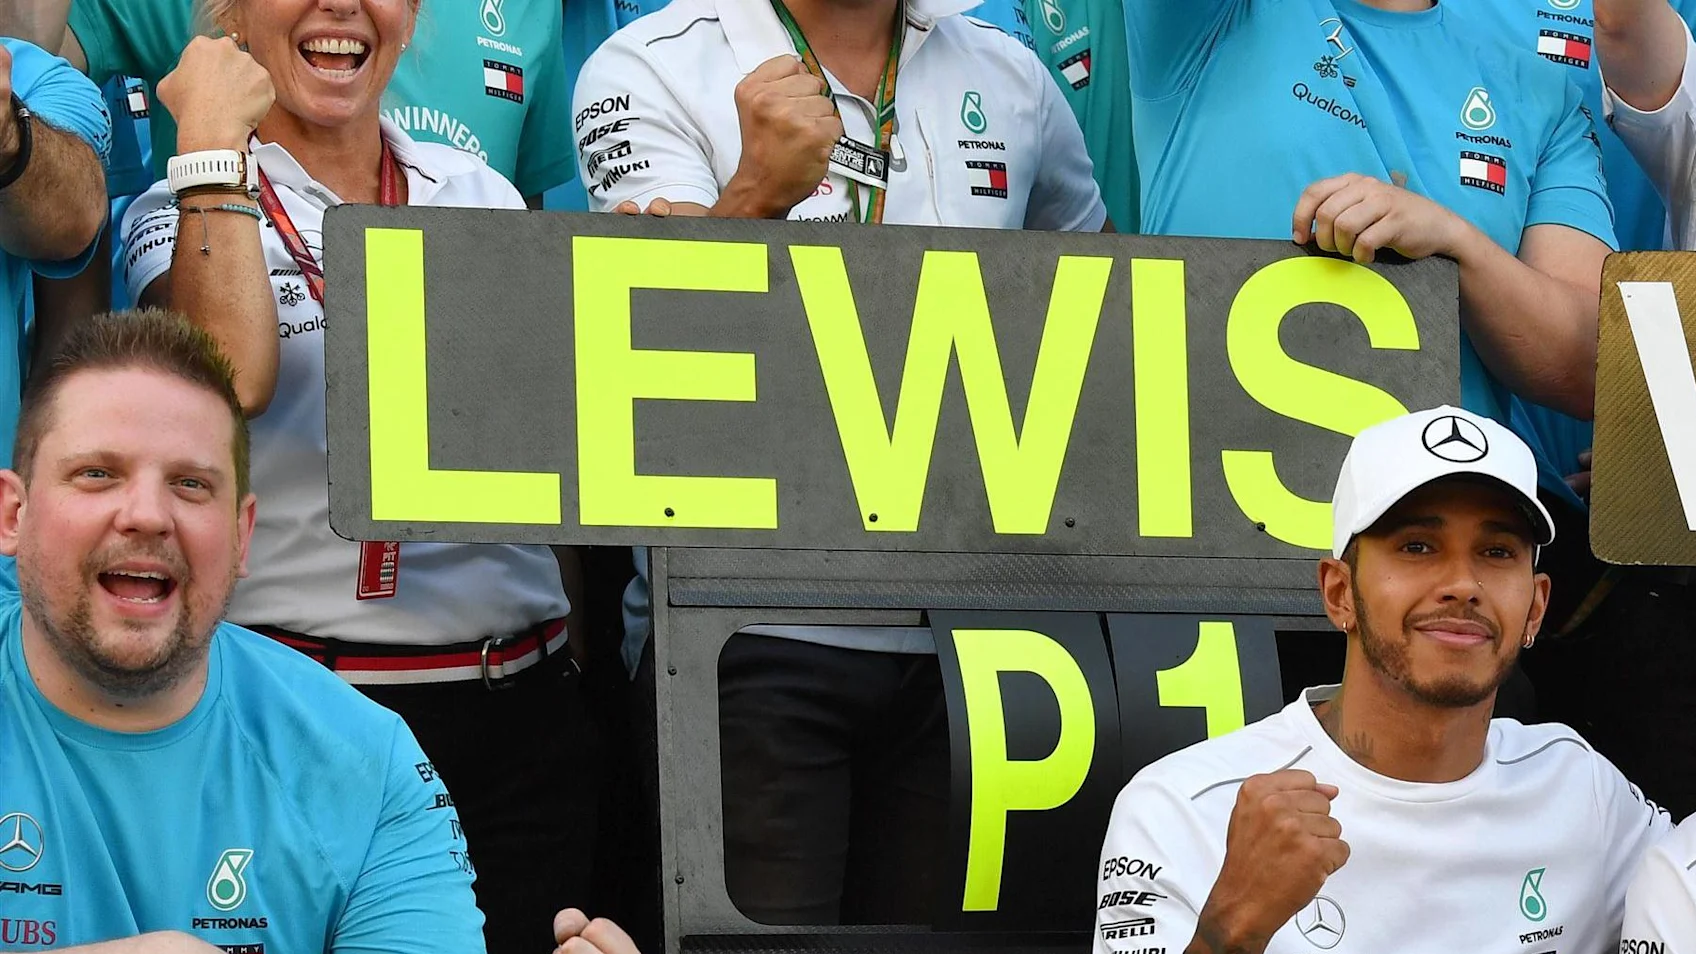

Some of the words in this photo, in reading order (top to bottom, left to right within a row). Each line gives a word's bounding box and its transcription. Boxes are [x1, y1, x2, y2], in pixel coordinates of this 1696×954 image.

[1536, 10, 1594, 27] PETRONAS
[1543, 30, 1588, 43] TOMMY
[477, 36, 523, 56] PETRONAS
[487, 61, 522, 75] TOMMY
[1061, 52, 1089, 68] TOMM
[575, 94, 630, 133] EPSON
[1292, 82, 1368, 129] Qualcom
[958, 140, 1006, 151] PETRONAS
[1455, 131, 1512, 148] PETRONAS
[968, 161, 1005, 171] TOMMY
[1464, 151, 1506, 167] TOMMY
[1464, 177, 1504, 193] HILFIGER
[279, 315, 329, 339] Qualc
[365, 228, 1420, 550] LEWIS
[1103, 856, 1163, 881] EPSON
[1099, 890, 1168, 910] BOSE
[2, 918, 57, 946] UBS
[192, 917, 268, 930] PETRONAS
[1100, 917, 1155, 940] RELLI
[1518, 925, 1564, 945] PETRONAS
[227, 945, 260, 954] MMY
